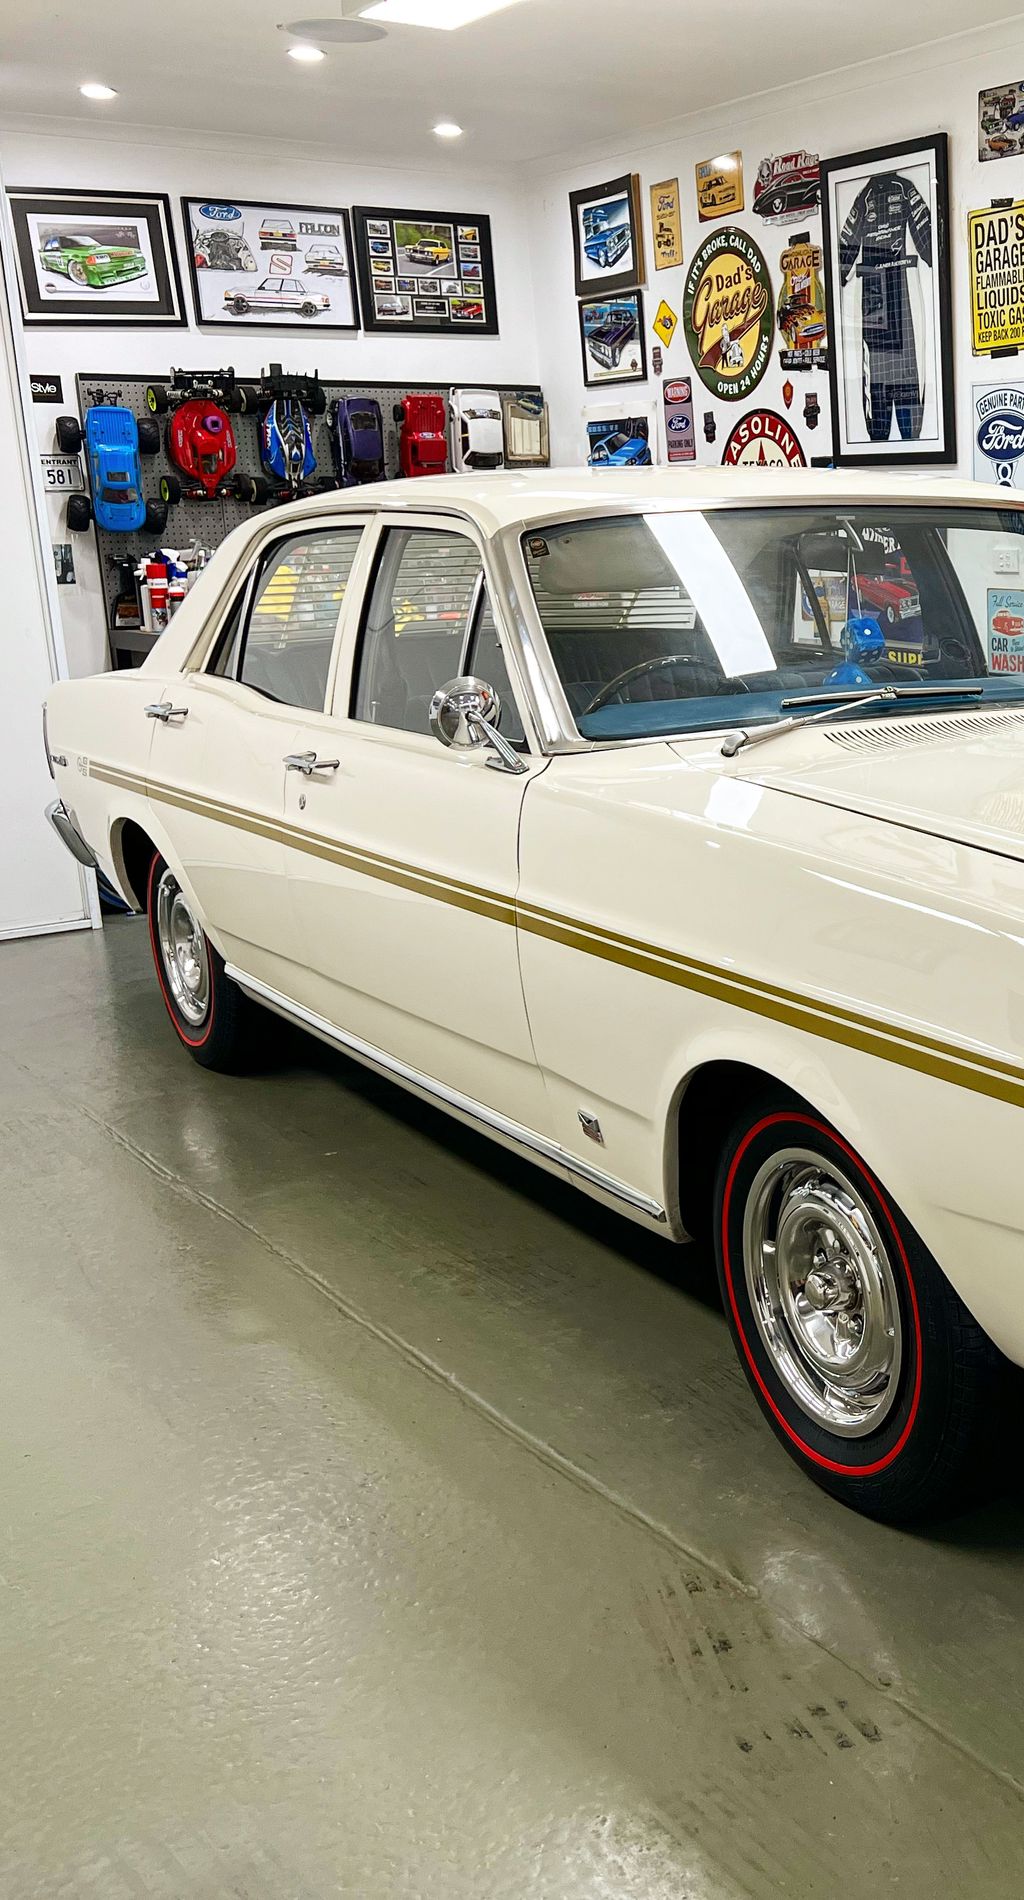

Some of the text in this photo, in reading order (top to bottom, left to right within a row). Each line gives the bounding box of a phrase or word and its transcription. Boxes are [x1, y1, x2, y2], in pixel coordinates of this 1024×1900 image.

[208, 206, 340, 236] Ford FALCON
[687, 281, 695, 294] IF
[729, 235, 746, 253] CALL
[747, 247, 761, 273] DAD
[781, 250, 820, 270] GARAGE
[715, 264, 753, 292] Dad's
[692, 275, 763, 333] Garage
[977, 308, 1006, 330] TOXIC
[978, 330, 992, 343] KEEP
[993, 328, 1009, 342] BACK
[1010, 327, 1020, 339] 200
[717, 381, 739, 395] OPEN
[740, 375, 751, 391] 24
[751, 334, 769, 379] HOURS
[980, 393, 1008, 415] GENUINE
[671, 417, 686, 429] Ford
[725, 416, 800, 467] ASOLINE
[47, 469, 73, 485] 581
[992, 594, 1023, 608] Full Service
[992, 637, 1008, 652] CAR
[991, 653, 1024, 673] WASH
